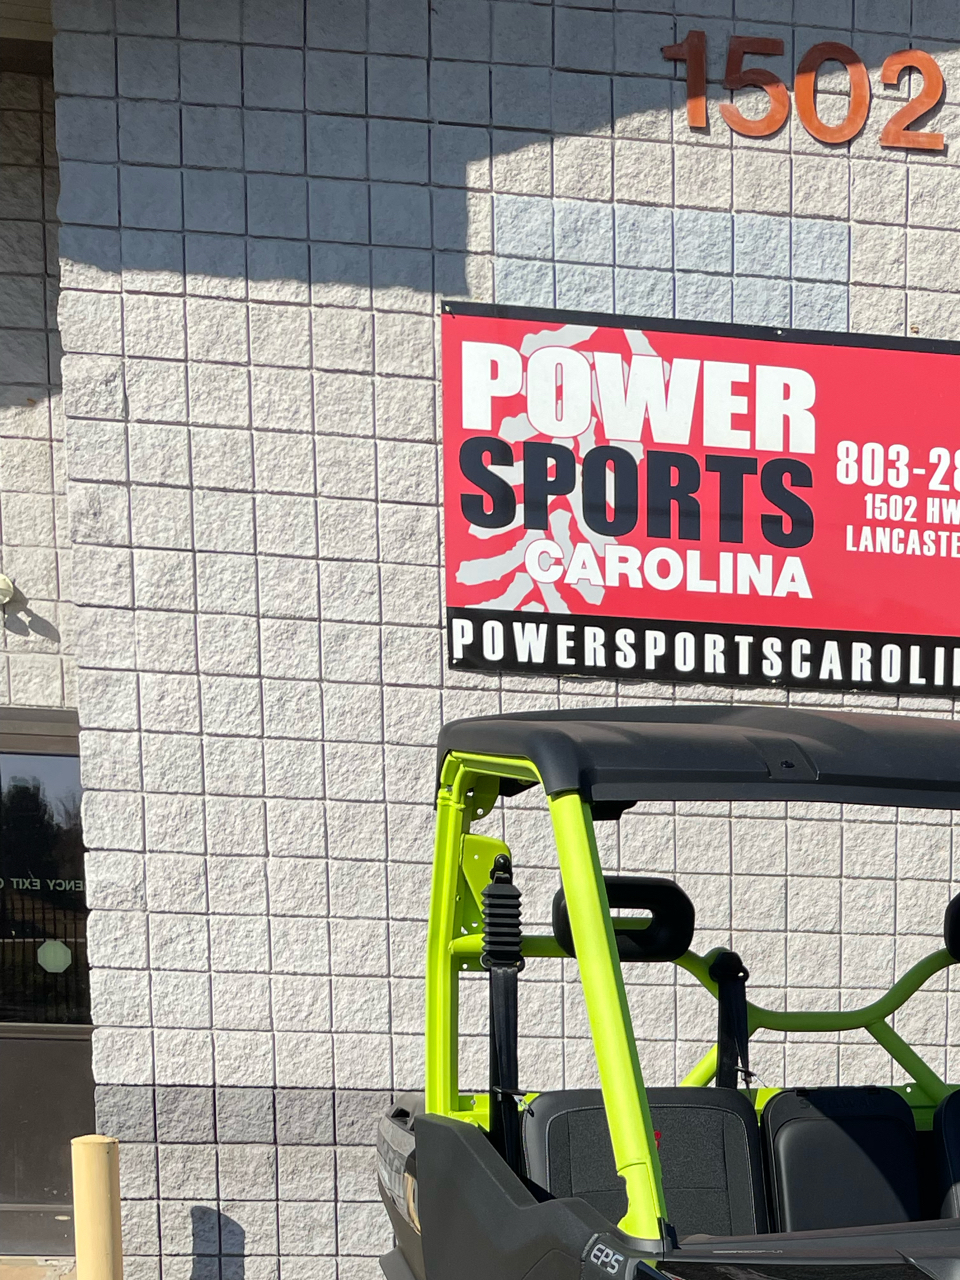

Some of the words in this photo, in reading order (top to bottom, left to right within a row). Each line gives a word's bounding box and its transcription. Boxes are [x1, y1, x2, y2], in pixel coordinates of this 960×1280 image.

[663, 30, 945, 150] 1502
[461, 340, 816, 454] POWER
[459, 436, 814, 549] SPORTS
[864, 493, 918, 522] 1502
[525, 538, 813, 599] CAROLINA
[590, 1243, 624, 1274] EPS
